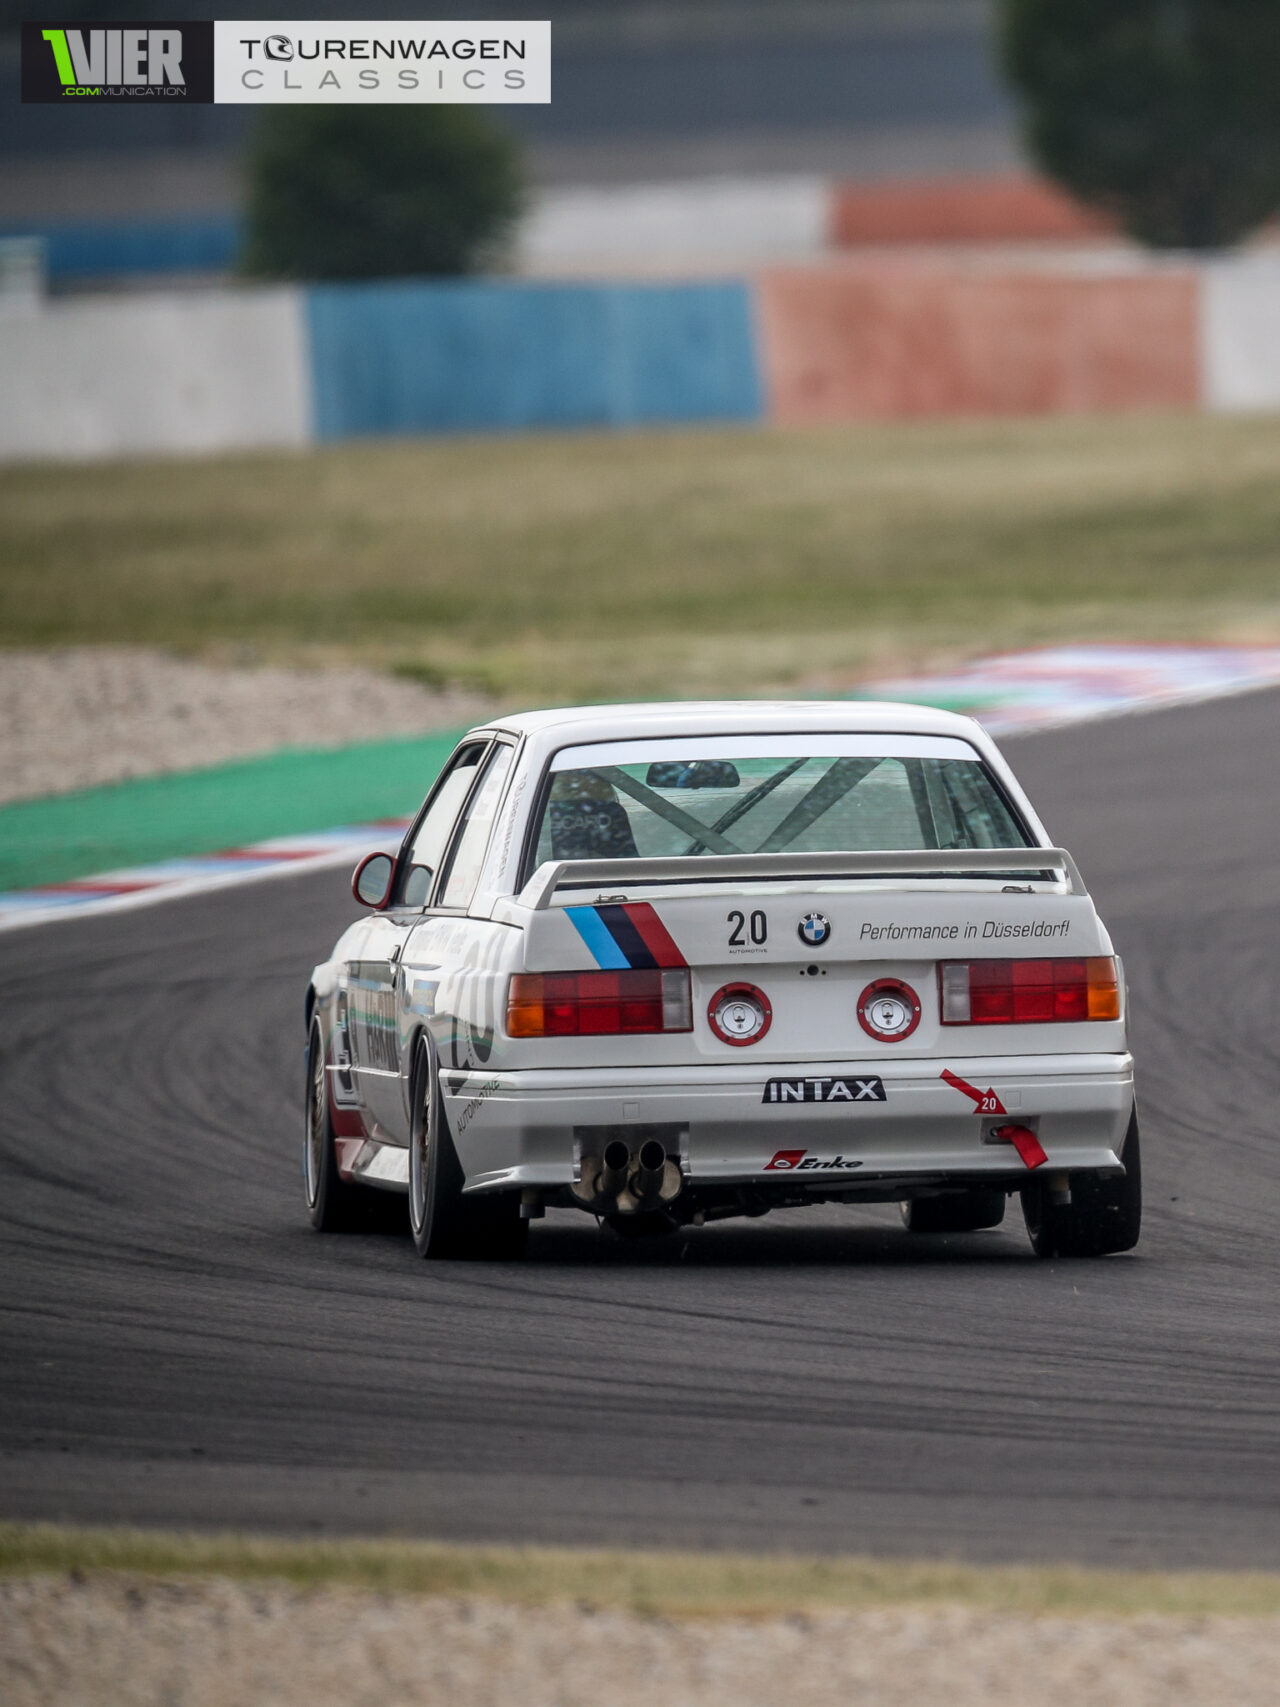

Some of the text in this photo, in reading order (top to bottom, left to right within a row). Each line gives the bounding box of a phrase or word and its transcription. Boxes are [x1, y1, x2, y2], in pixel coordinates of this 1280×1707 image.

[727, 910, 768, 946] 20
[859, 920, 1070, 940] Performance in Düsseldorf!
[770, 1078, 880, 1101] INTAX
[982, 1097, 997, 1110] 20
[797, 1156, 864, 1170] Enke
